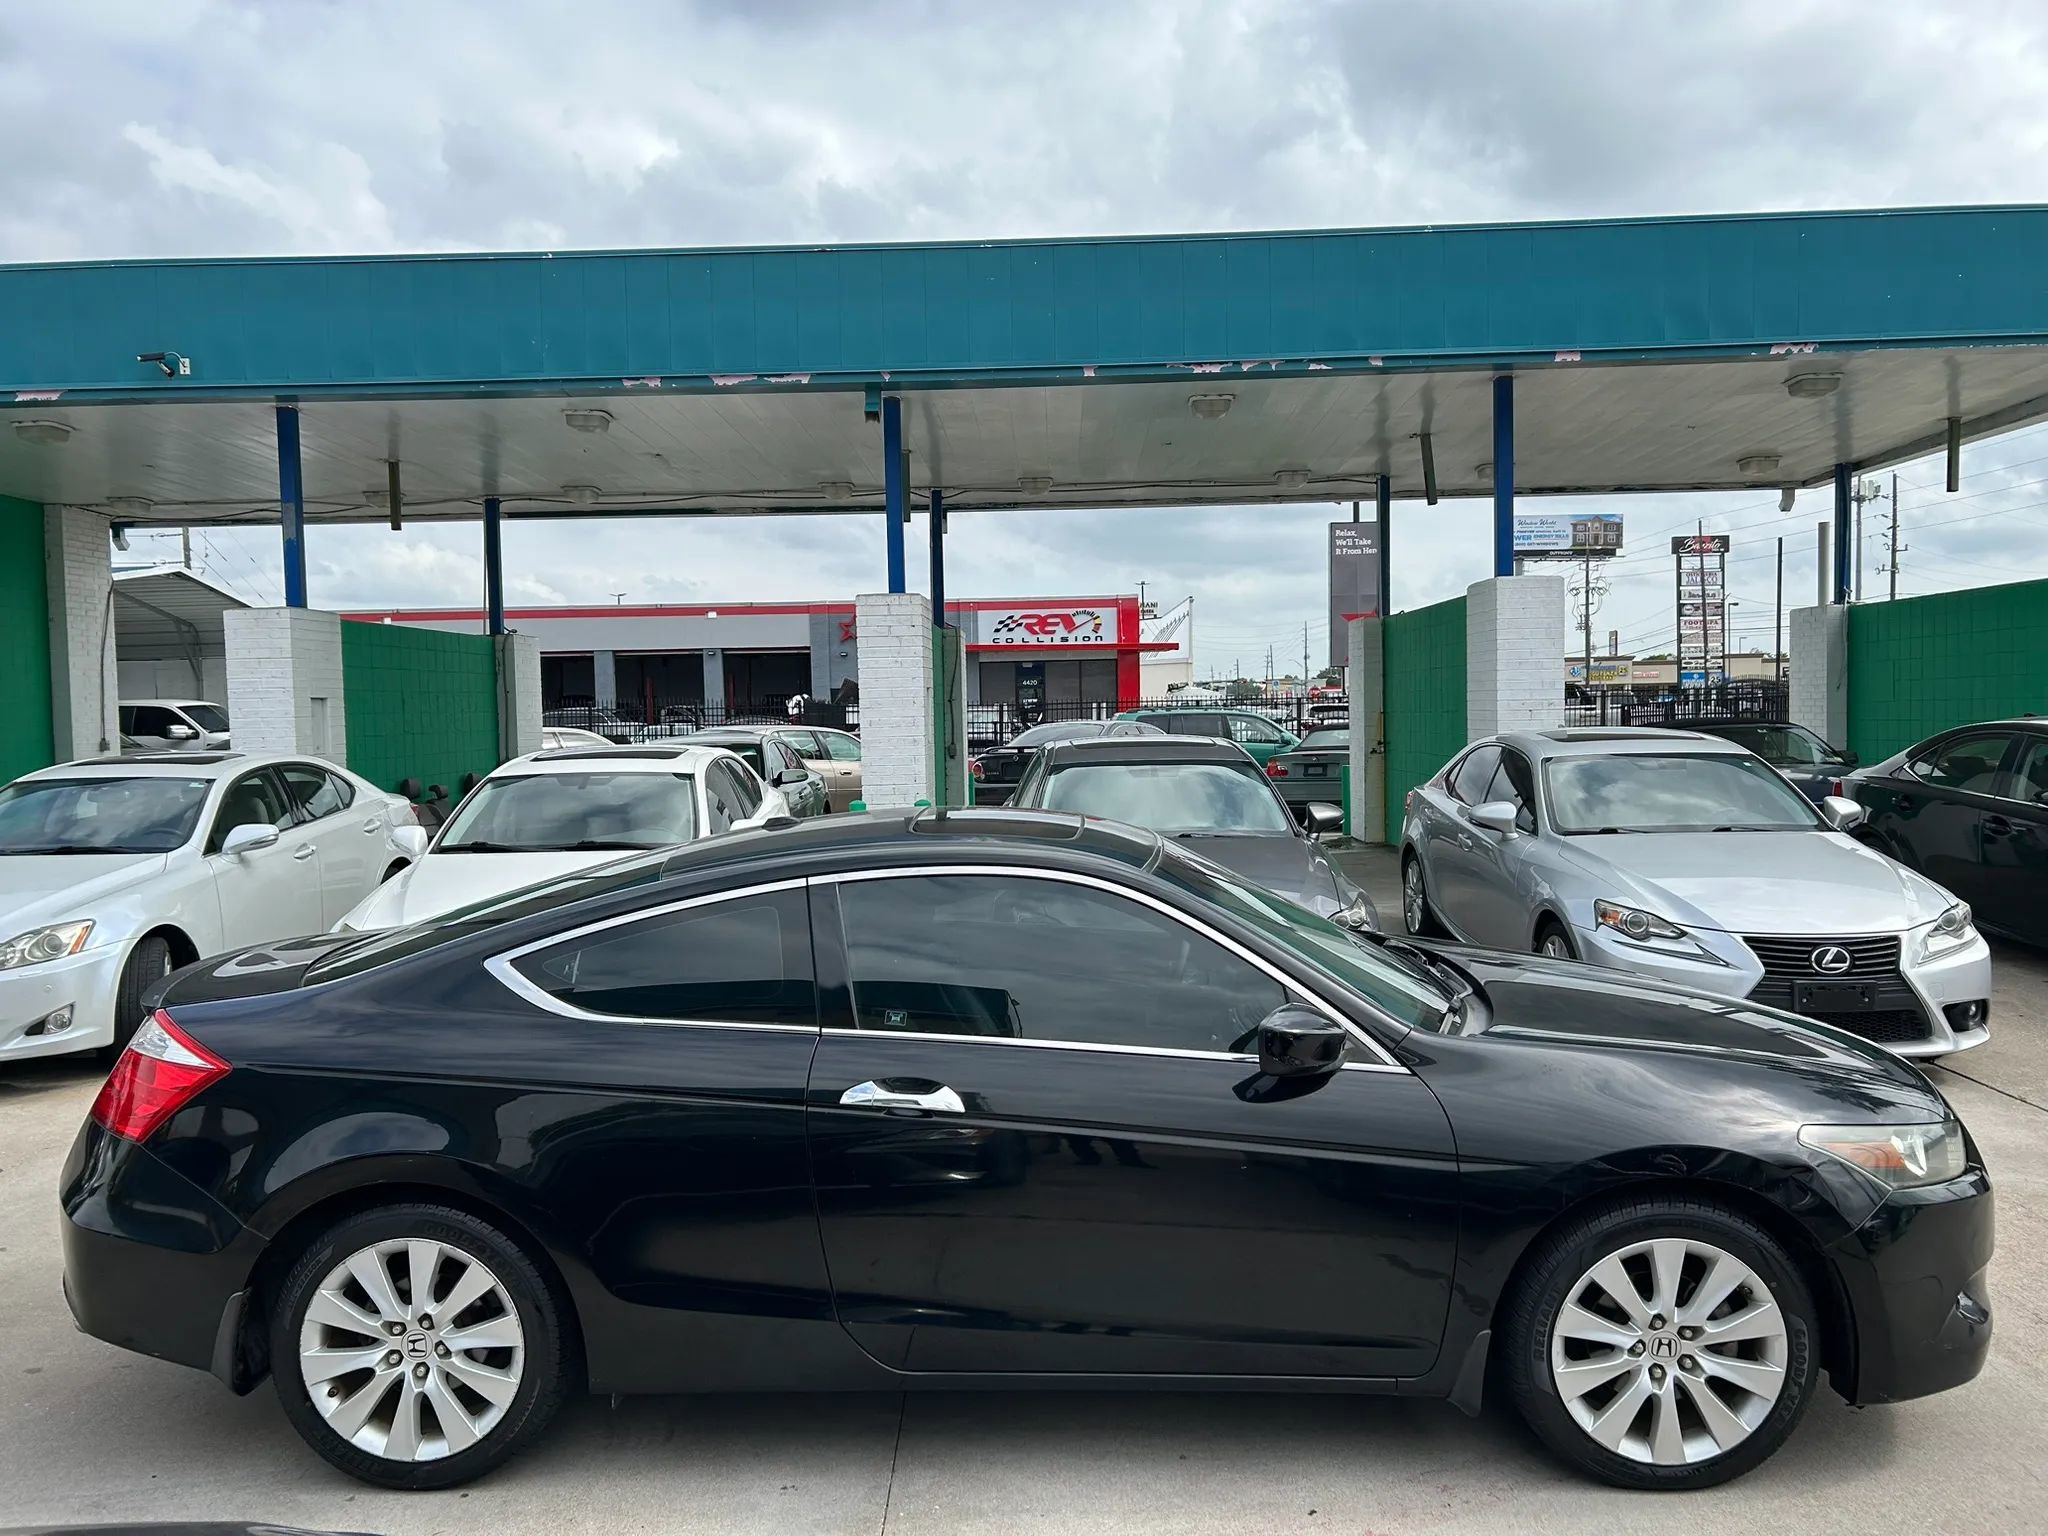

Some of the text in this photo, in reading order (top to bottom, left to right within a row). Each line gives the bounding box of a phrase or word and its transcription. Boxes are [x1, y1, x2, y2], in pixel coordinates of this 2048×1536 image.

[1335, 529, 1358, 537] Relax,
[1335, 538, 1372, 546] We'll Take
[1342, 547, 1362, 555] From
[1686, 576, 1718, 585] JALCO
[1012, 613, 1084, 635] REV
[992, 635, 1103, 644] COLLISION
[1773, 1328, 1808, 1433] GOODYEA
